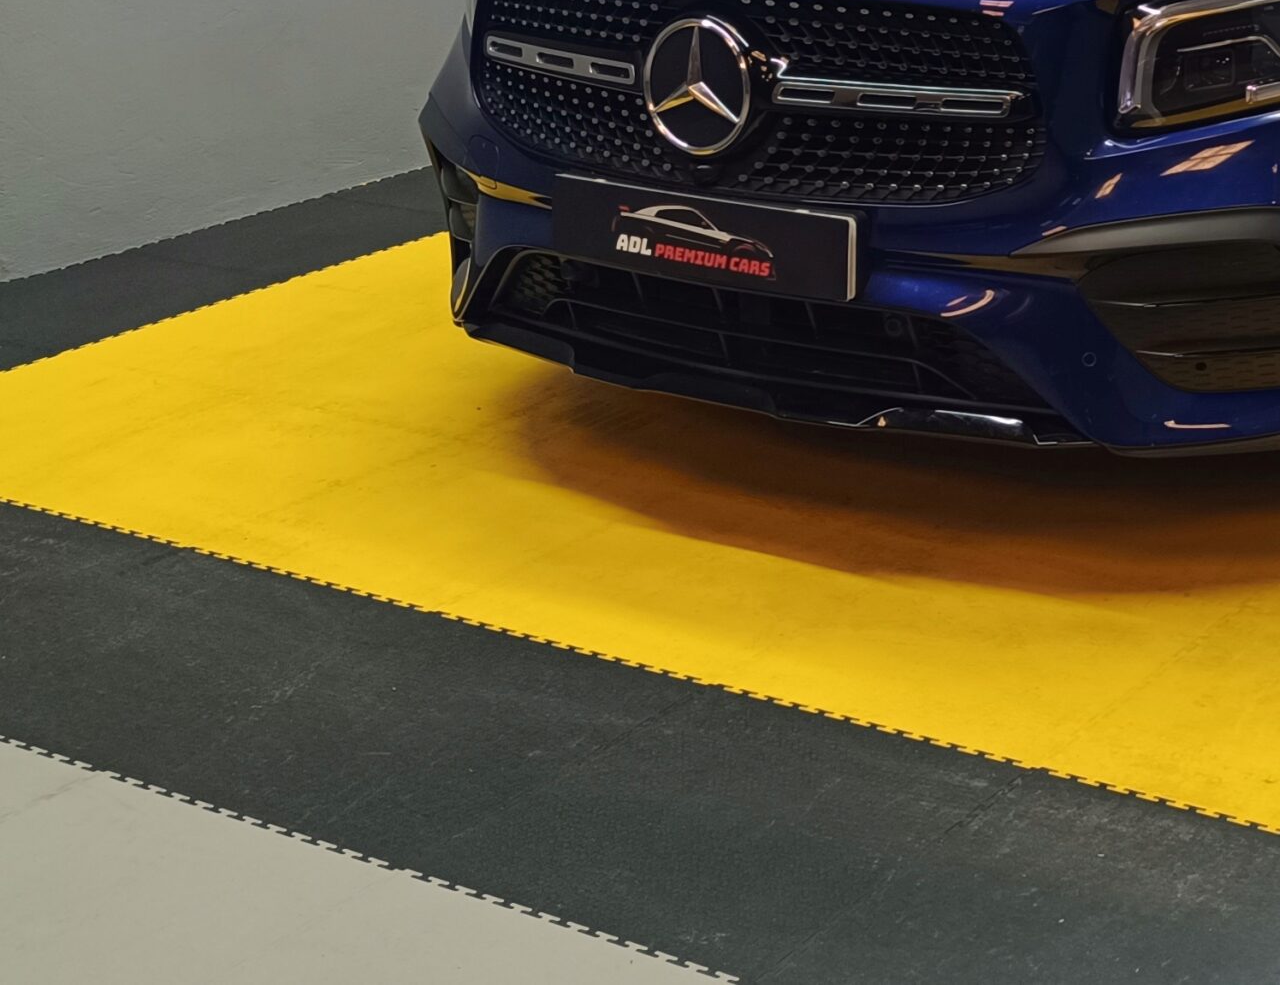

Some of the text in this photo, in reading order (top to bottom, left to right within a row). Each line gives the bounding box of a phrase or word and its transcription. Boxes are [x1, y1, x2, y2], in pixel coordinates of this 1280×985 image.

[616, 234, 770, 276] ADL PREMIUM CARS
